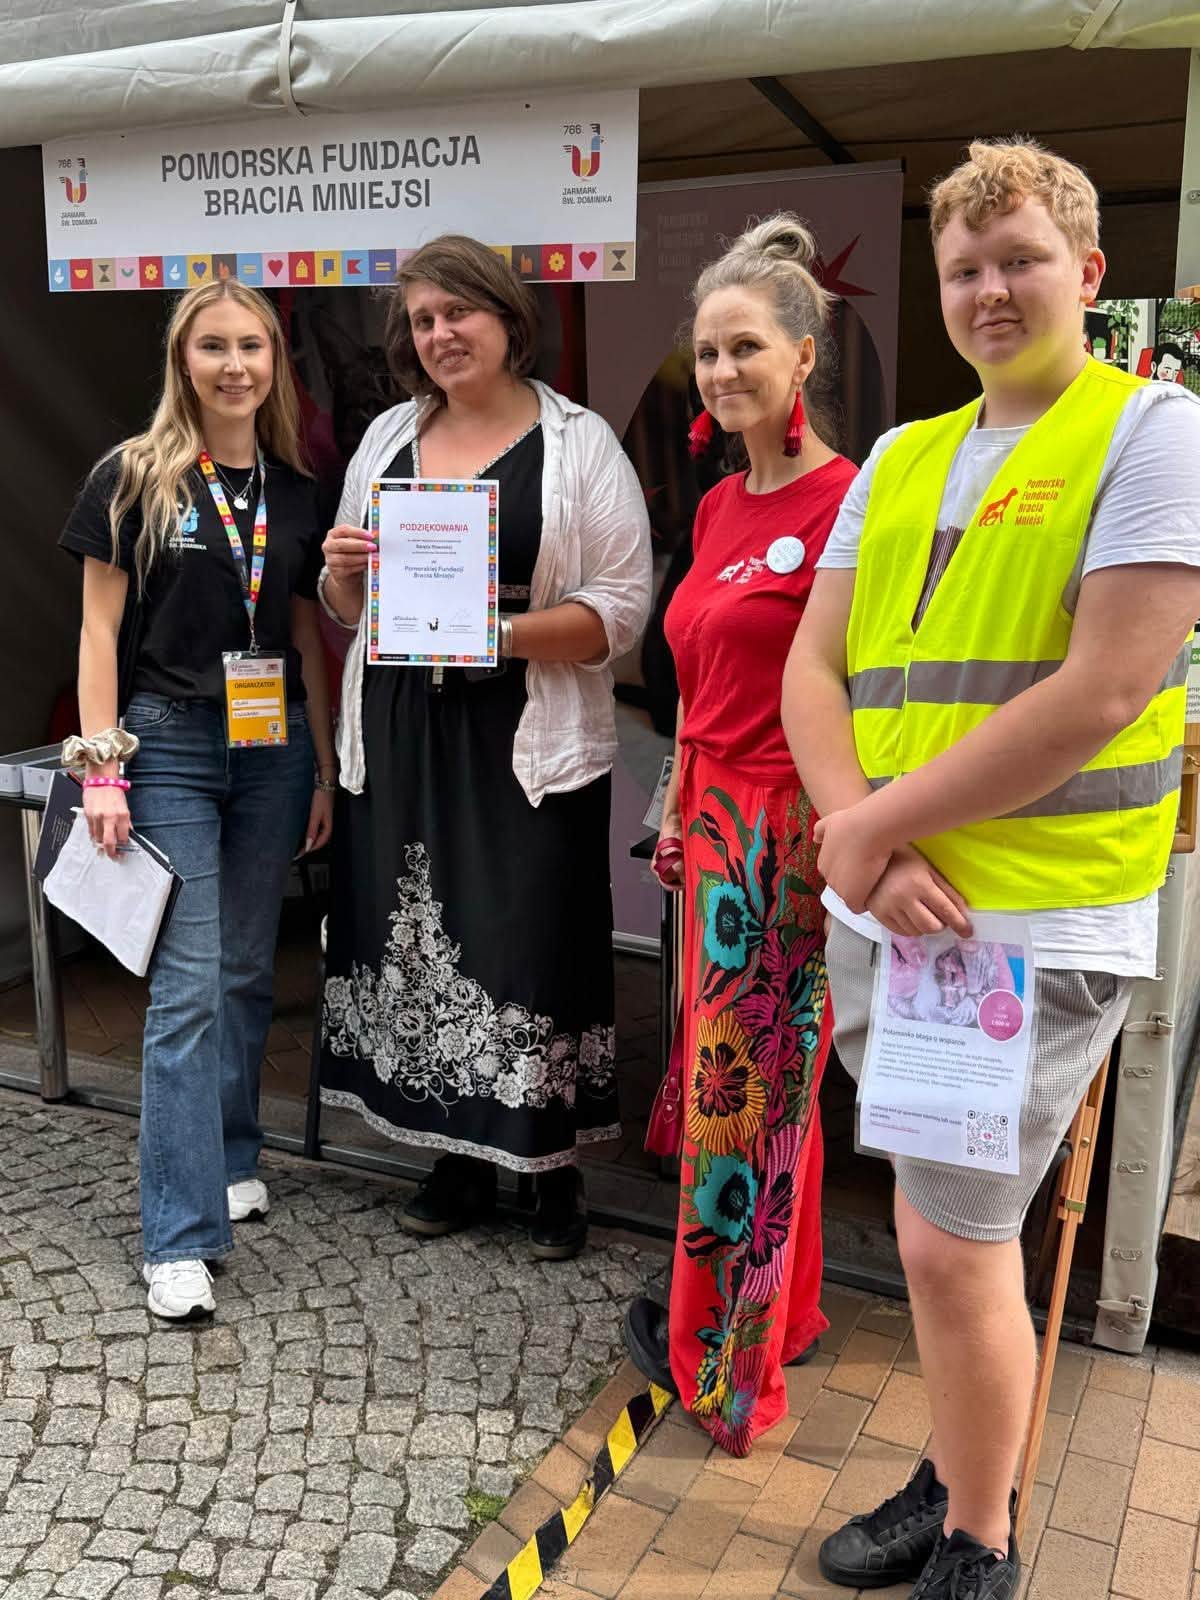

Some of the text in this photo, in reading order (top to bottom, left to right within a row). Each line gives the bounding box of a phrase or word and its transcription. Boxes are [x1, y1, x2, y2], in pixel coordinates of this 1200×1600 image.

[562, 125, 582, 135] 766
[161, 135, 481, 182] POMORSKA FUNDACJA
[58, 159, 72, 168] 766
[562, 187, 598, 196] JARMARK
[204, 178, 431, 216] BRACIA MNIEJSI
[577, 195, 613, 204] DOMINIKA
[1026, 479, 1065, 488] Pomorska
[400, 523, 469, 533] PODZIĘKOWANIA
